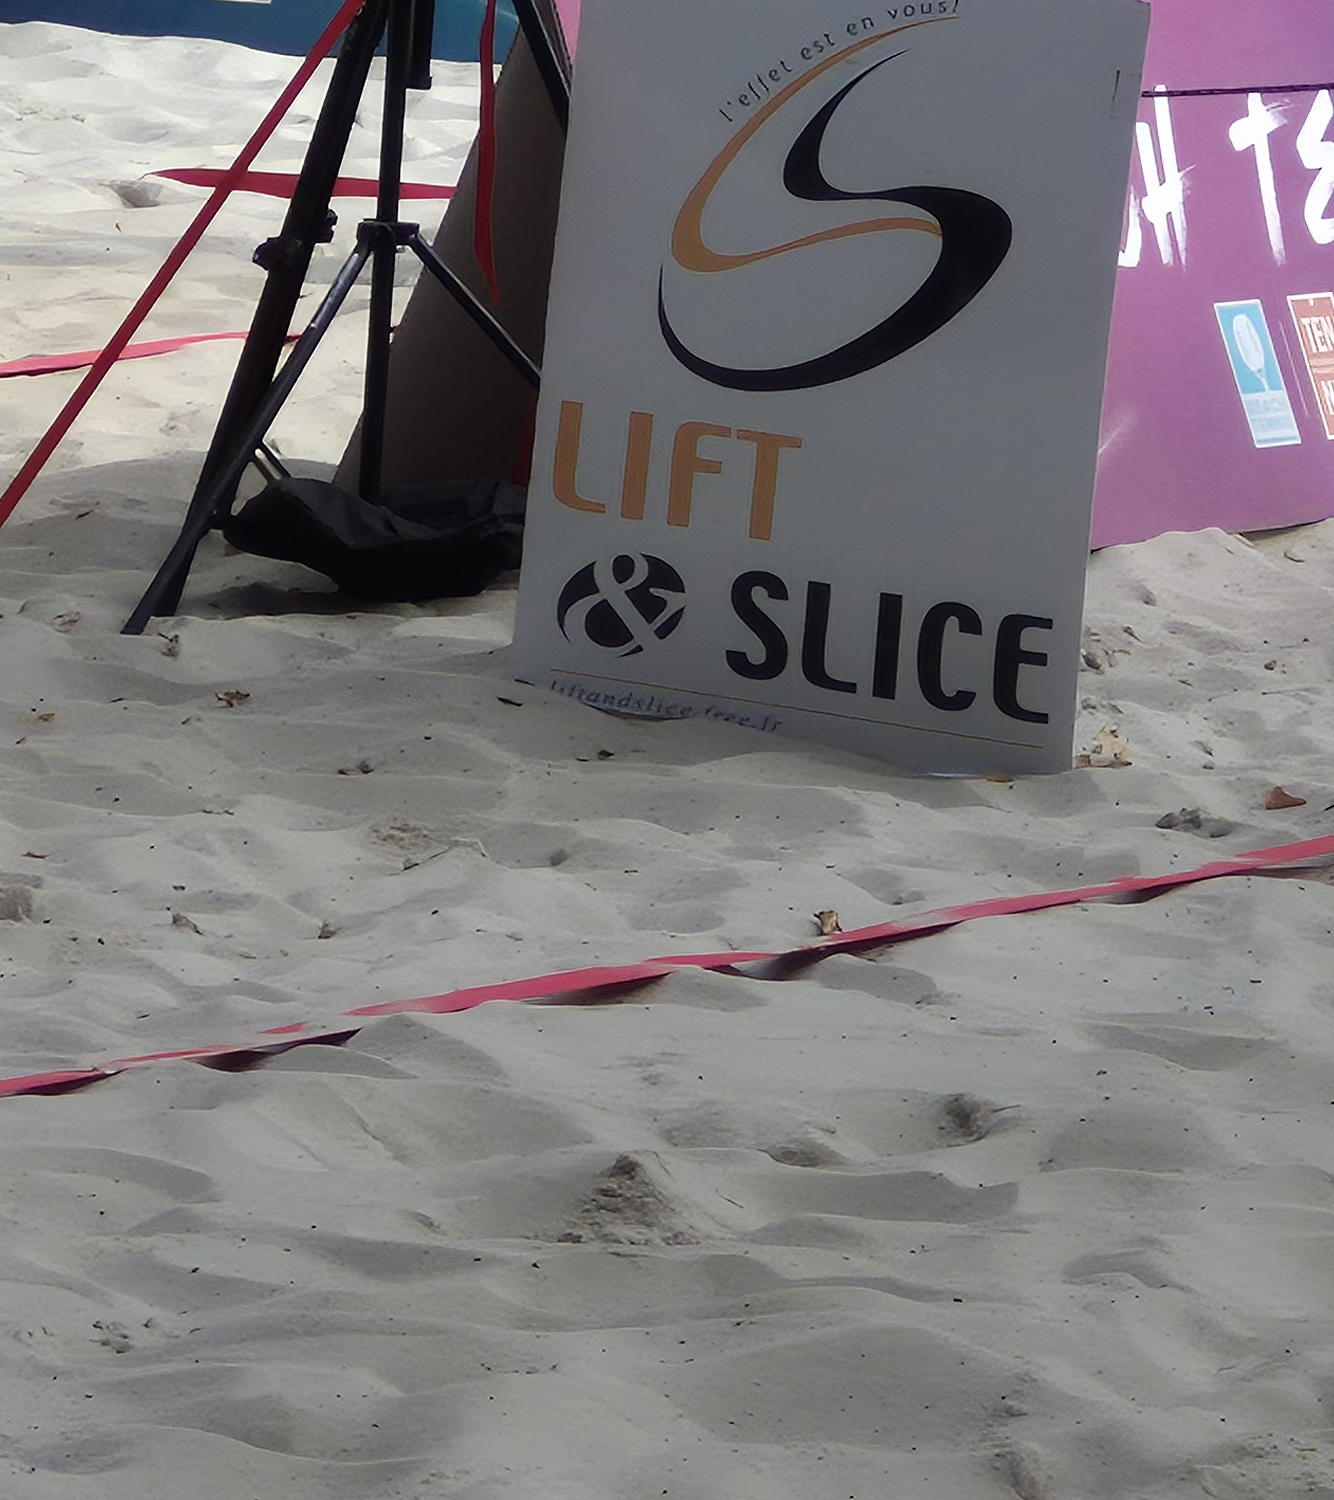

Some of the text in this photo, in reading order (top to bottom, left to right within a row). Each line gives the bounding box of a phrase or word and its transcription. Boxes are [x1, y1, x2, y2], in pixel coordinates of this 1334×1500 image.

[719, 60, 793, 123] l'effet
[801, 33, 835, 60] est
[846, 16, 875, 36] en
[552, 400, 803, 541] LIFT
[725, 569, 1054, 725] SLICE
